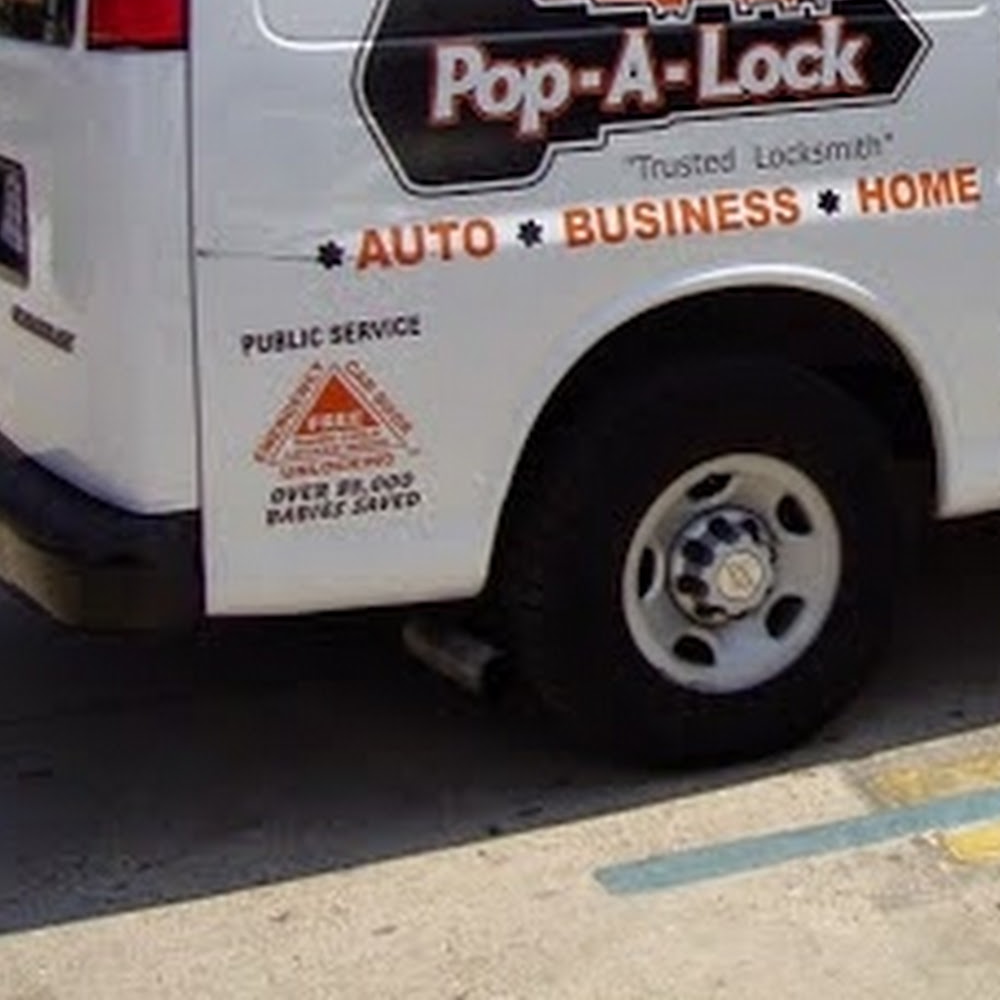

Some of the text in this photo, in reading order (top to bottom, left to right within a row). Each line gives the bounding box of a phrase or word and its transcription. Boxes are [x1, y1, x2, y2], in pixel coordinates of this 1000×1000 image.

[429, 15, 871, 138] Pop-A-Lock
[354, 165, 983, 271] AUTO BUSINESS HOME
[240, 314, 422, 357] PUBLIC SERVICE
[269, 481, 330, 506] OVER
[351, 490, 423, 516] SAVED
